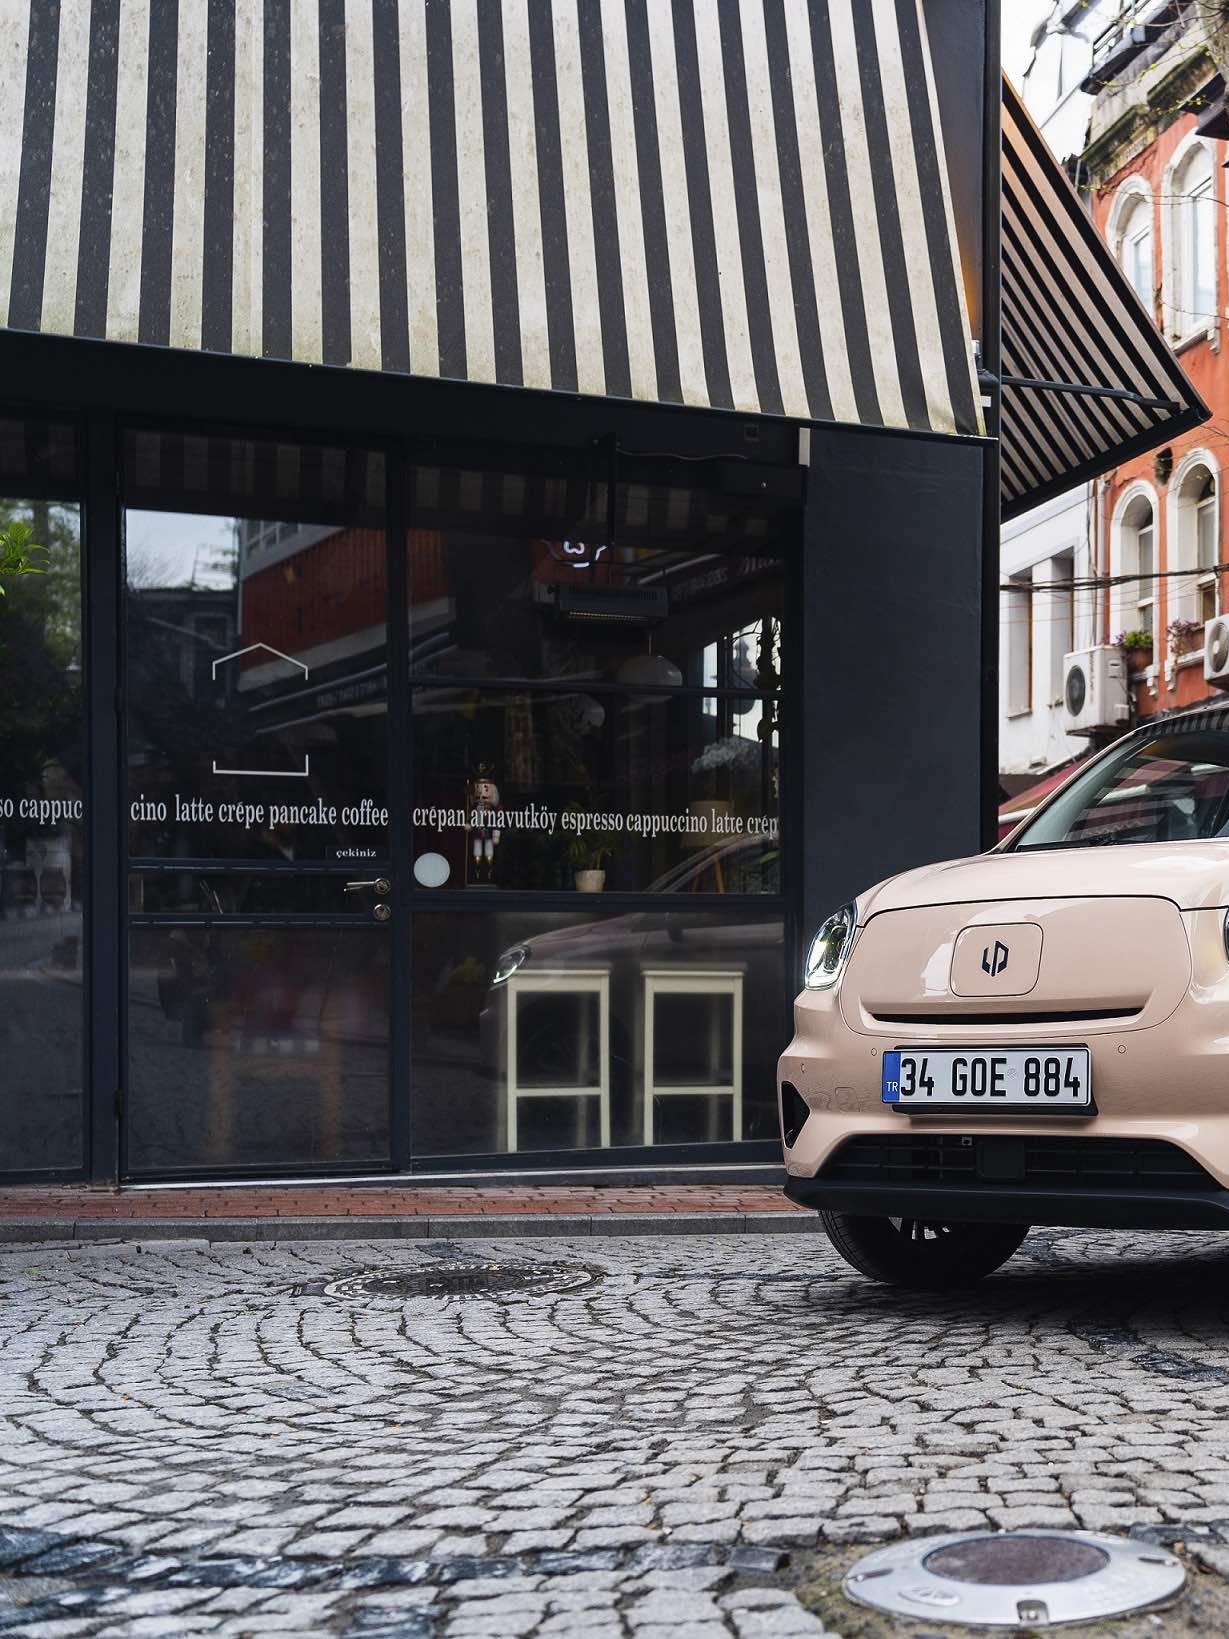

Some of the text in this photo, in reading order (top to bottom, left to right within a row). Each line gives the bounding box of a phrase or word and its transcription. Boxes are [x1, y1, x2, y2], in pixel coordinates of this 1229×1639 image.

[19, 798, 83, 825] cappuc
[130, 794, 167, 822] cino
[175, 794, 214, 823] latte
[269, 798, 337, 830] pancake
[341, 799, 389, 827] coffee
[413, 806, 466, 832] crépan
[470, 803, 557, 835] arnavutköy
[561, 810, 623, 836] espresso
[626, 808, 708, 838] cappuccino
[711, 808, 743, 834] latte
[336, 847, 377, 859] çekiniz
[886, 1057, 1081, 1097] TR 34 GOE 884
